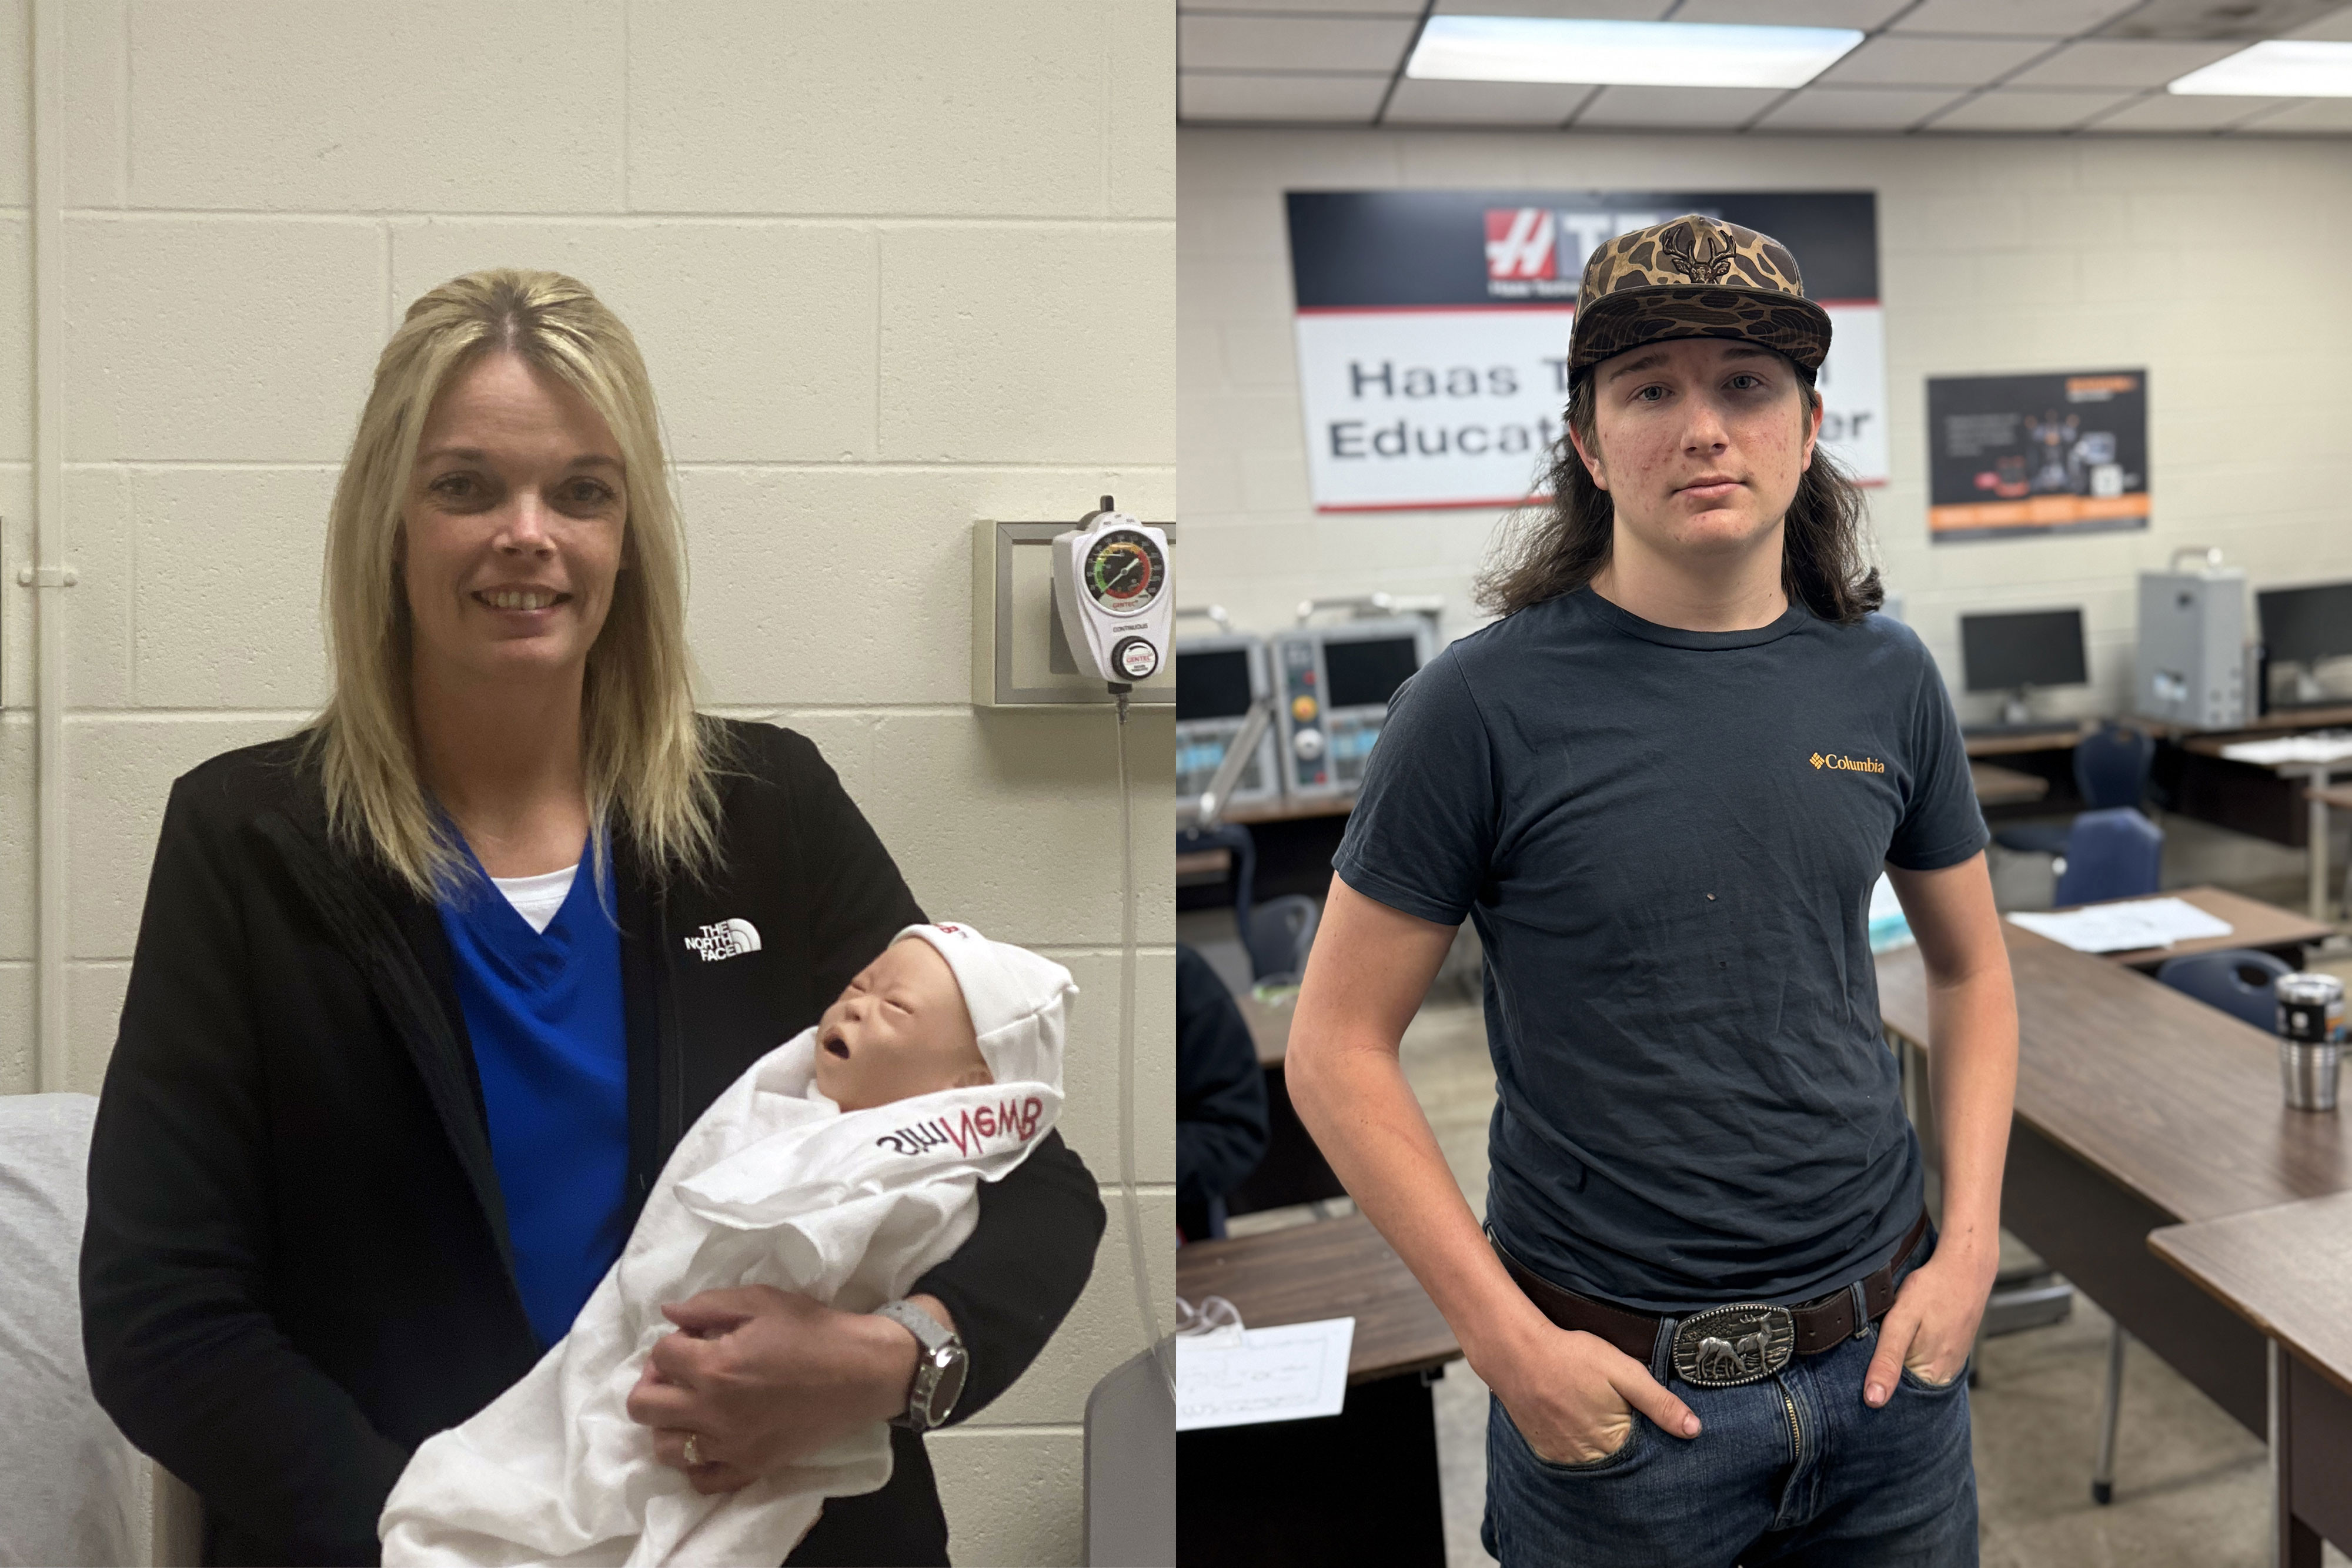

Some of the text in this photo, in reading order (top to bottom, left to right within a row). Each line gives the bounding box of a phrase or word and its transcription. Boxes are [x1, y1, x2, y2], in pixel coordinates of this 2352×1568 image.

[1349, 359, 1519, 398] Haas
[1328, 416, 1553, 459] Educat
[1113, 623, 1148, 633] CONTINUOUS
[1825, 754, 1885, 773] Columbia
[699, 921, 730, 938] THE
[684, 932, 733, 950] NORTH
[700, 944, 737, 961] FACE
